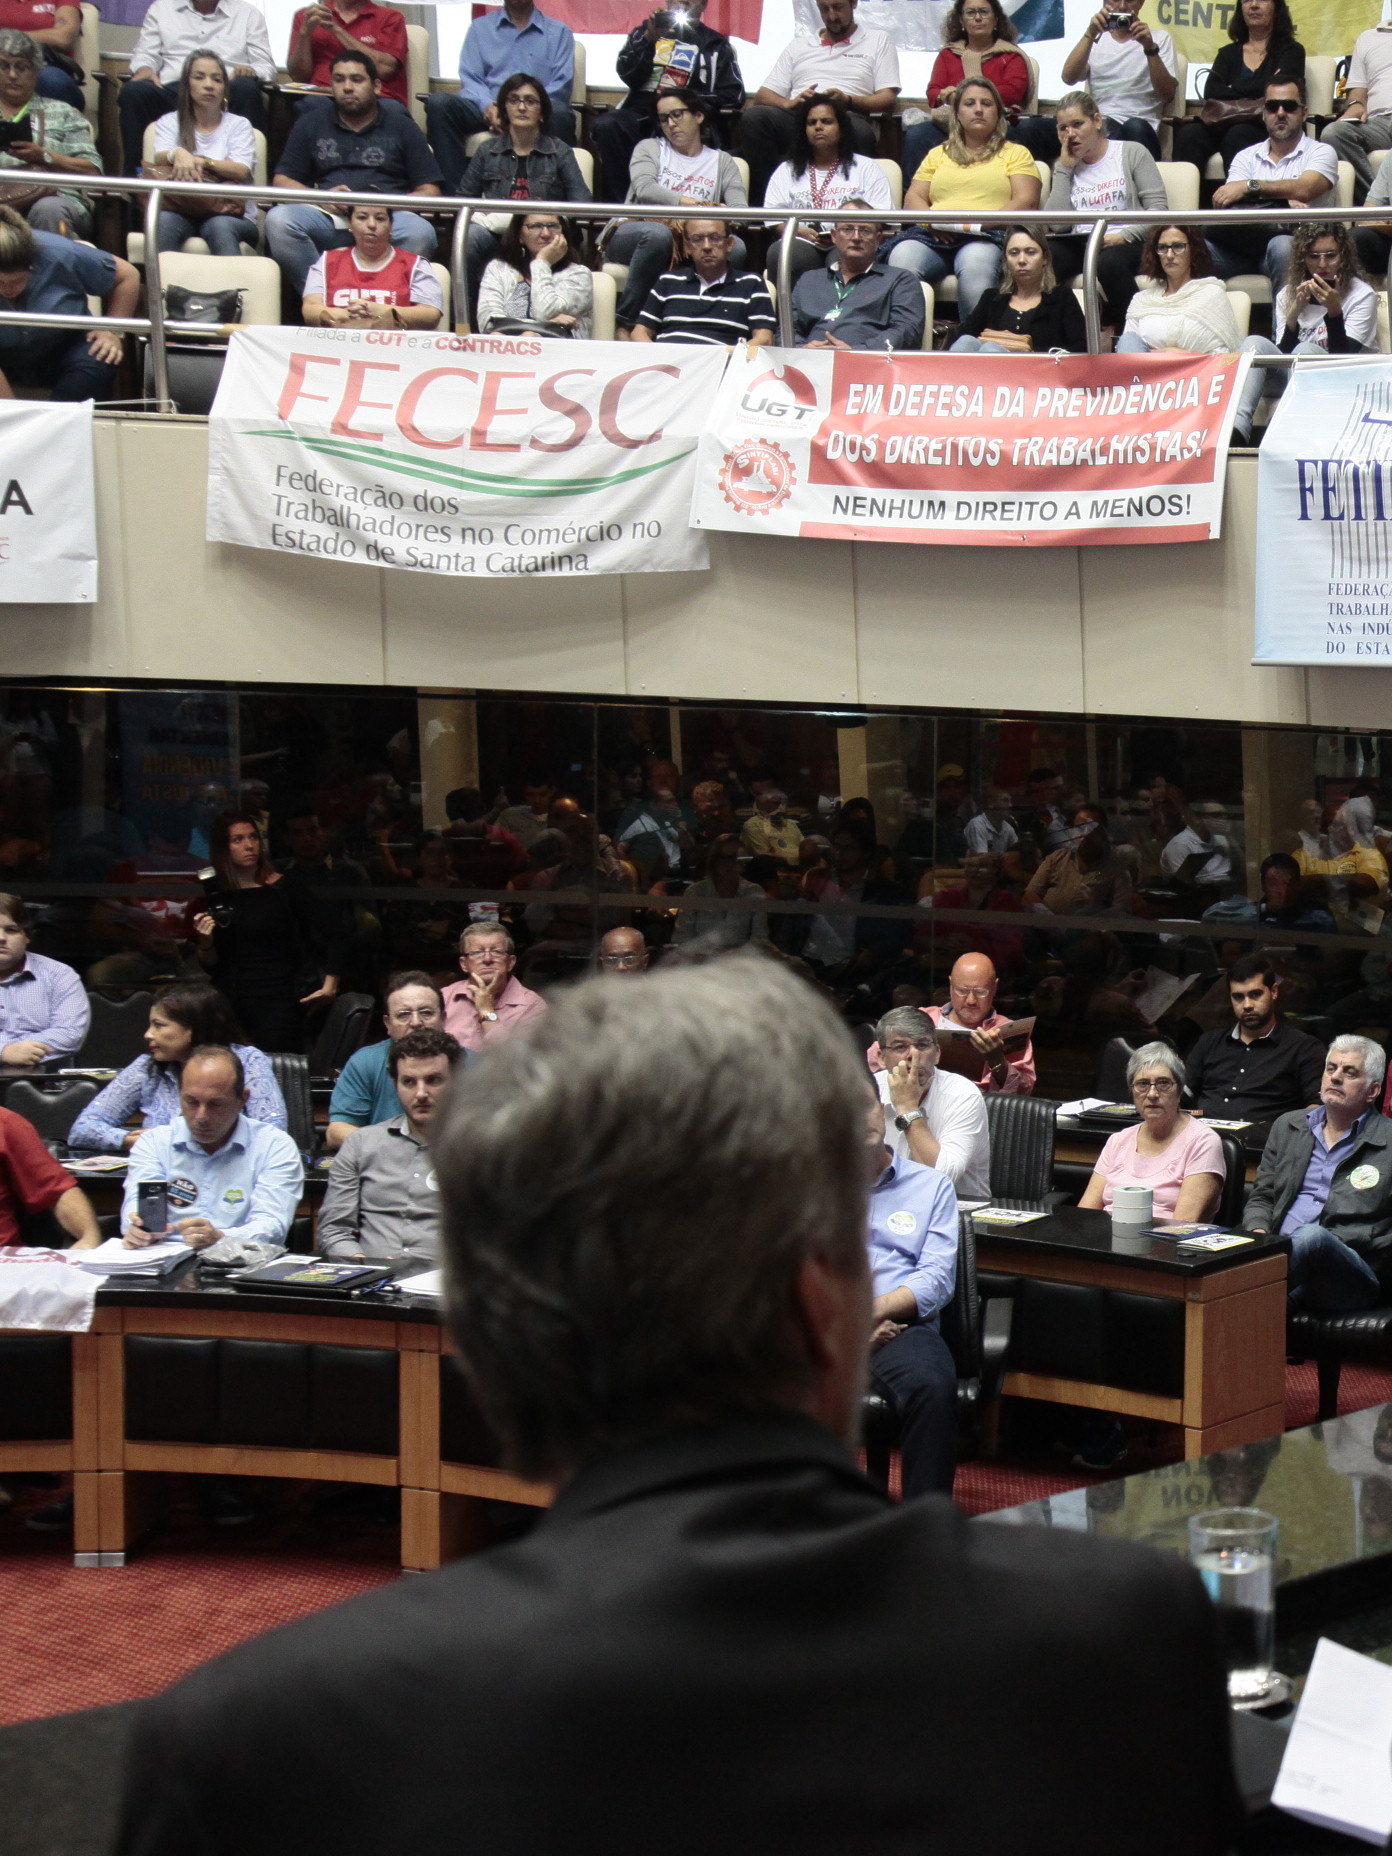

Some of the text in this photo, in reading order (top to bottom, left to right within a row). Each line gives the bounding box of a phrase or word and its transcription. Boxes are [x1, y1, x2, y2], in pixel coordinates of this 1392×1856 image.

[316, 138, 340, 159] 32
[693, 186, 711, 200] FAZ
[1089, 192, 1112, 206] LUTA
[1112, 190, 1127, 202] FA
[1097, 178, 1126, 192] DIREITO
[333, 288, 391, 307] CUT
[351, 333, 361, 343] a
[365, 331, 407, 346] CUT
[407, 337, 418, 348] e
[422, 339, 432, 350] a
[435, 336, 543, 356] CONTRACS
[277, 352, 681, 453] FECESC
[741, 393, 817, 420] UGT
[845, 373, 1226, 419] EM DEFESA DA PREVIDÊNCIA E
[826, 428, 1209, 467] DOS DIREITOS TRABALHISTAS!
[0, 479, 35, 515] A
[275, 464, 459, 515] Federação dos
[271, 493, 662, 546] Trabalhadores no Comércio no
[832, 493, 1192, 521] NENHUM DIREITO A MENOS!
[271, 523, 589, 574] Estado de Santa Catarina
[1326, 621, 1353, 635] NAS
[1325, 641, 1346, 655] DO
[176, 1179, 194, 1191] NÃO
